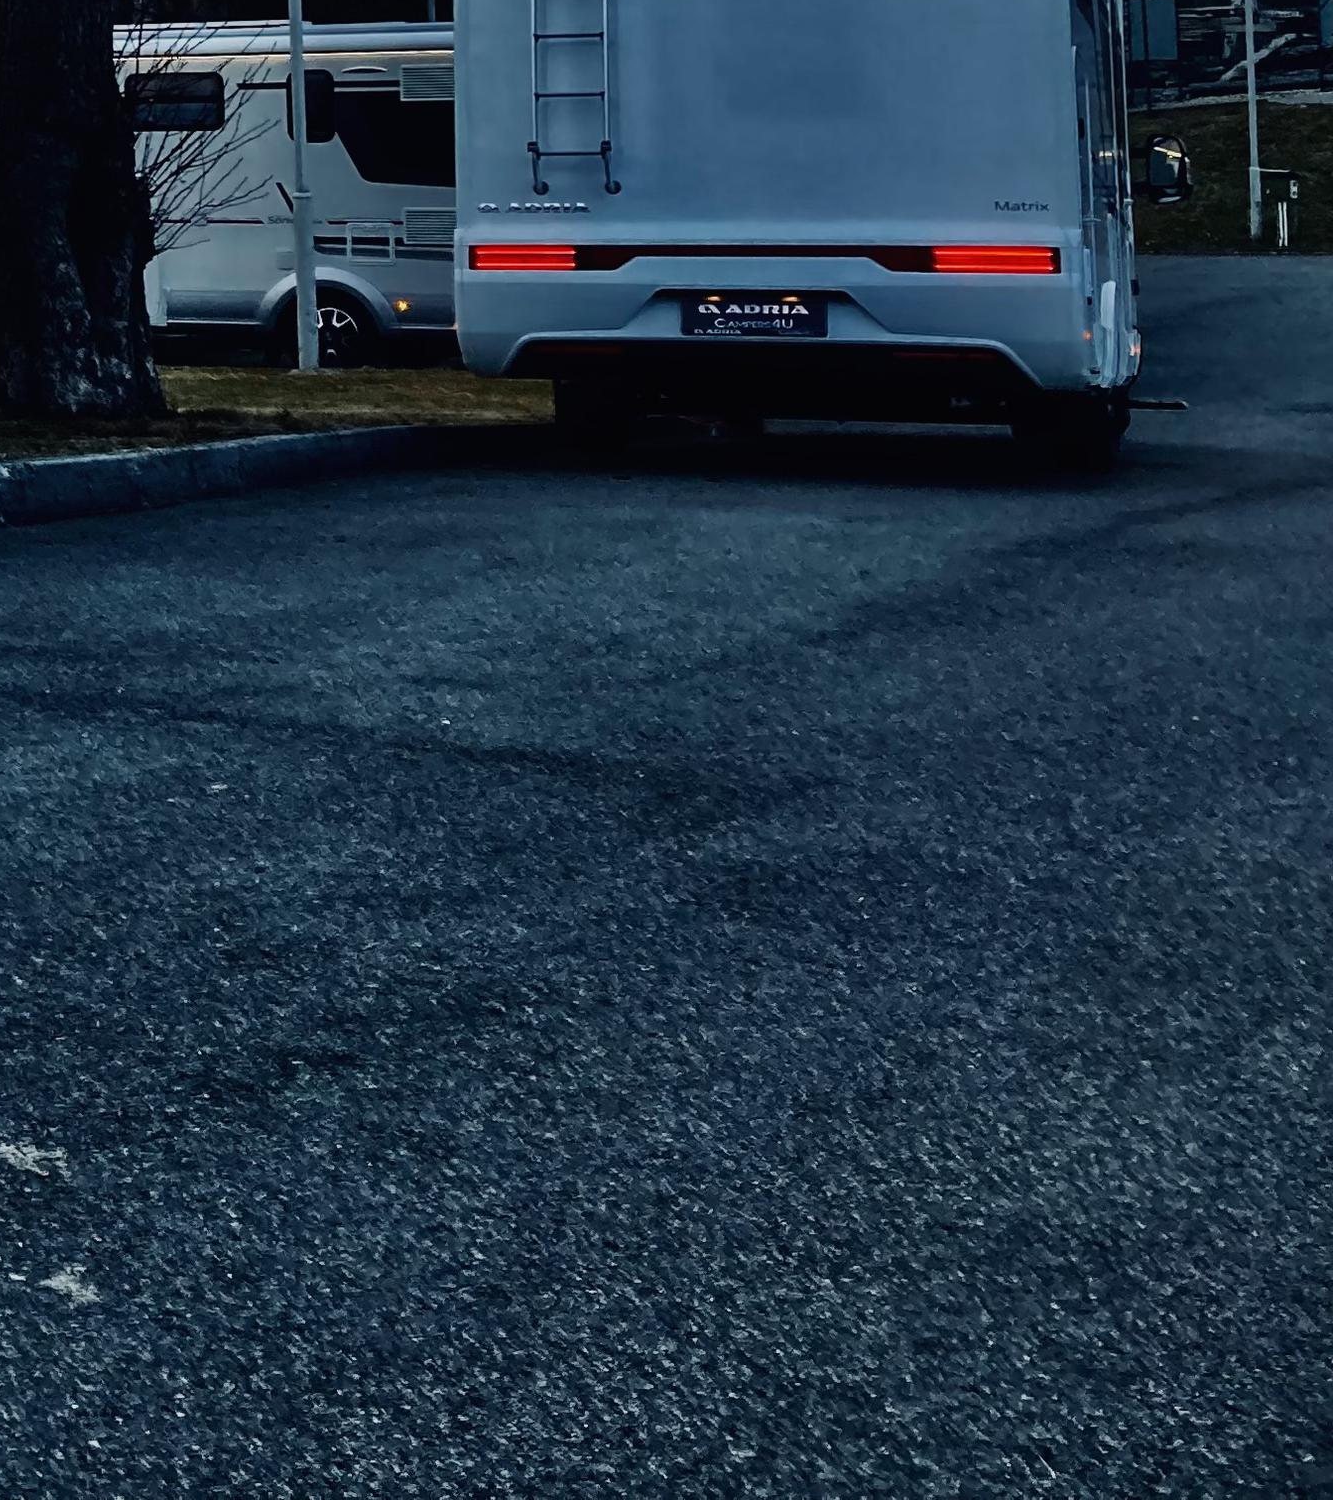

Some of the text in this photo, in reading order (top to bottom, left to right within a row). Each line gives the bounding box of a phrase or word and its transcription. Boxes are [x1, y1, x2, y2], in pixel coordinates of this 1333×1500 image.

[505, 202, 591, 213] ADRIA
[994, 201, 1049, 211] Matrix
[725, 304, 809, 315] ADRIA
